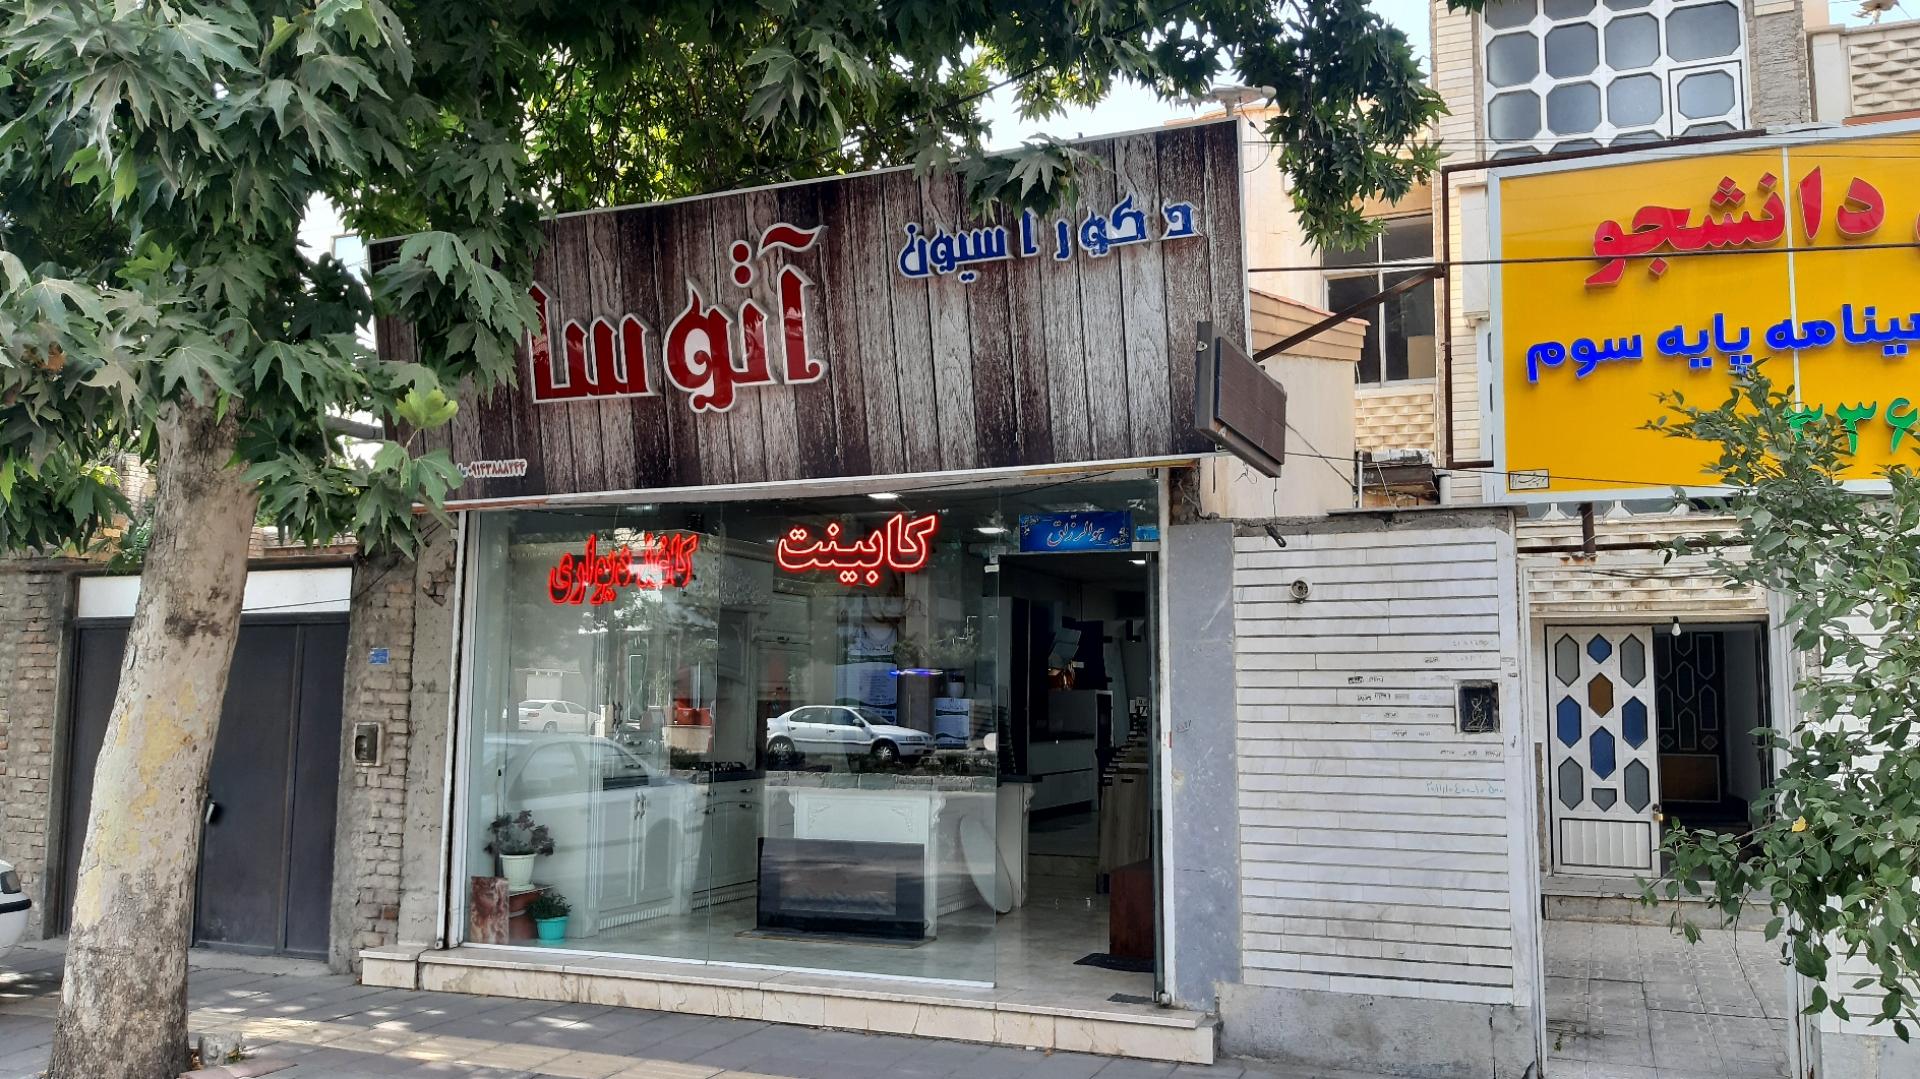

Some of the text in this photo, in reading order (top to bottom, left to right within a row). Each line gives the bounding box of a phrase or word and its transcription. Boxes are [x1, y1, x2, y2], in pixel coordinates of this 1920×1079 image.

[1585, 166, 1885, 290] دانشجو
[1525, 332, 1643, 384] سوم
[1656, 313, 1753, 374] پایه
[548, 532, 633, 605] دیواری
[776, 512, 937, 584] کابینت
